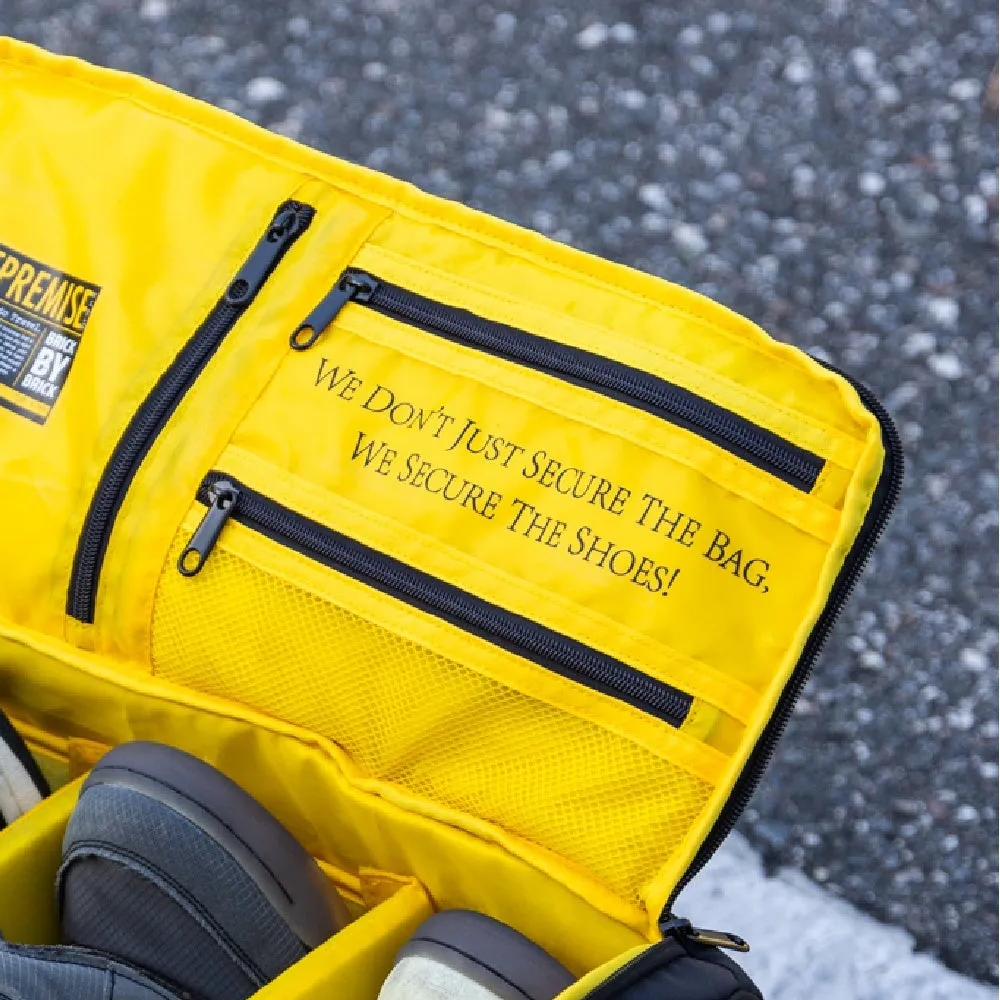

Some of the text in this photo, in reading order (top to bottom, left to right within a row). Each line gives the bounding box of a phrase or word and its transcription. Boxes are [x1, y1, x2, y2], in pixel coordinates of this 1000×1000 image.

[20, 373, 59, 398] BRICK
[30, 346, 72, 382] BY
[314, 357, 363, 401] WE
[446, 417, 526, 468] JUST
[522, 450, 632, 517] SECURE
[635, 493, 703, 548] THE
[351, 431, 681, 597] WE SECURE THE SHOES!
